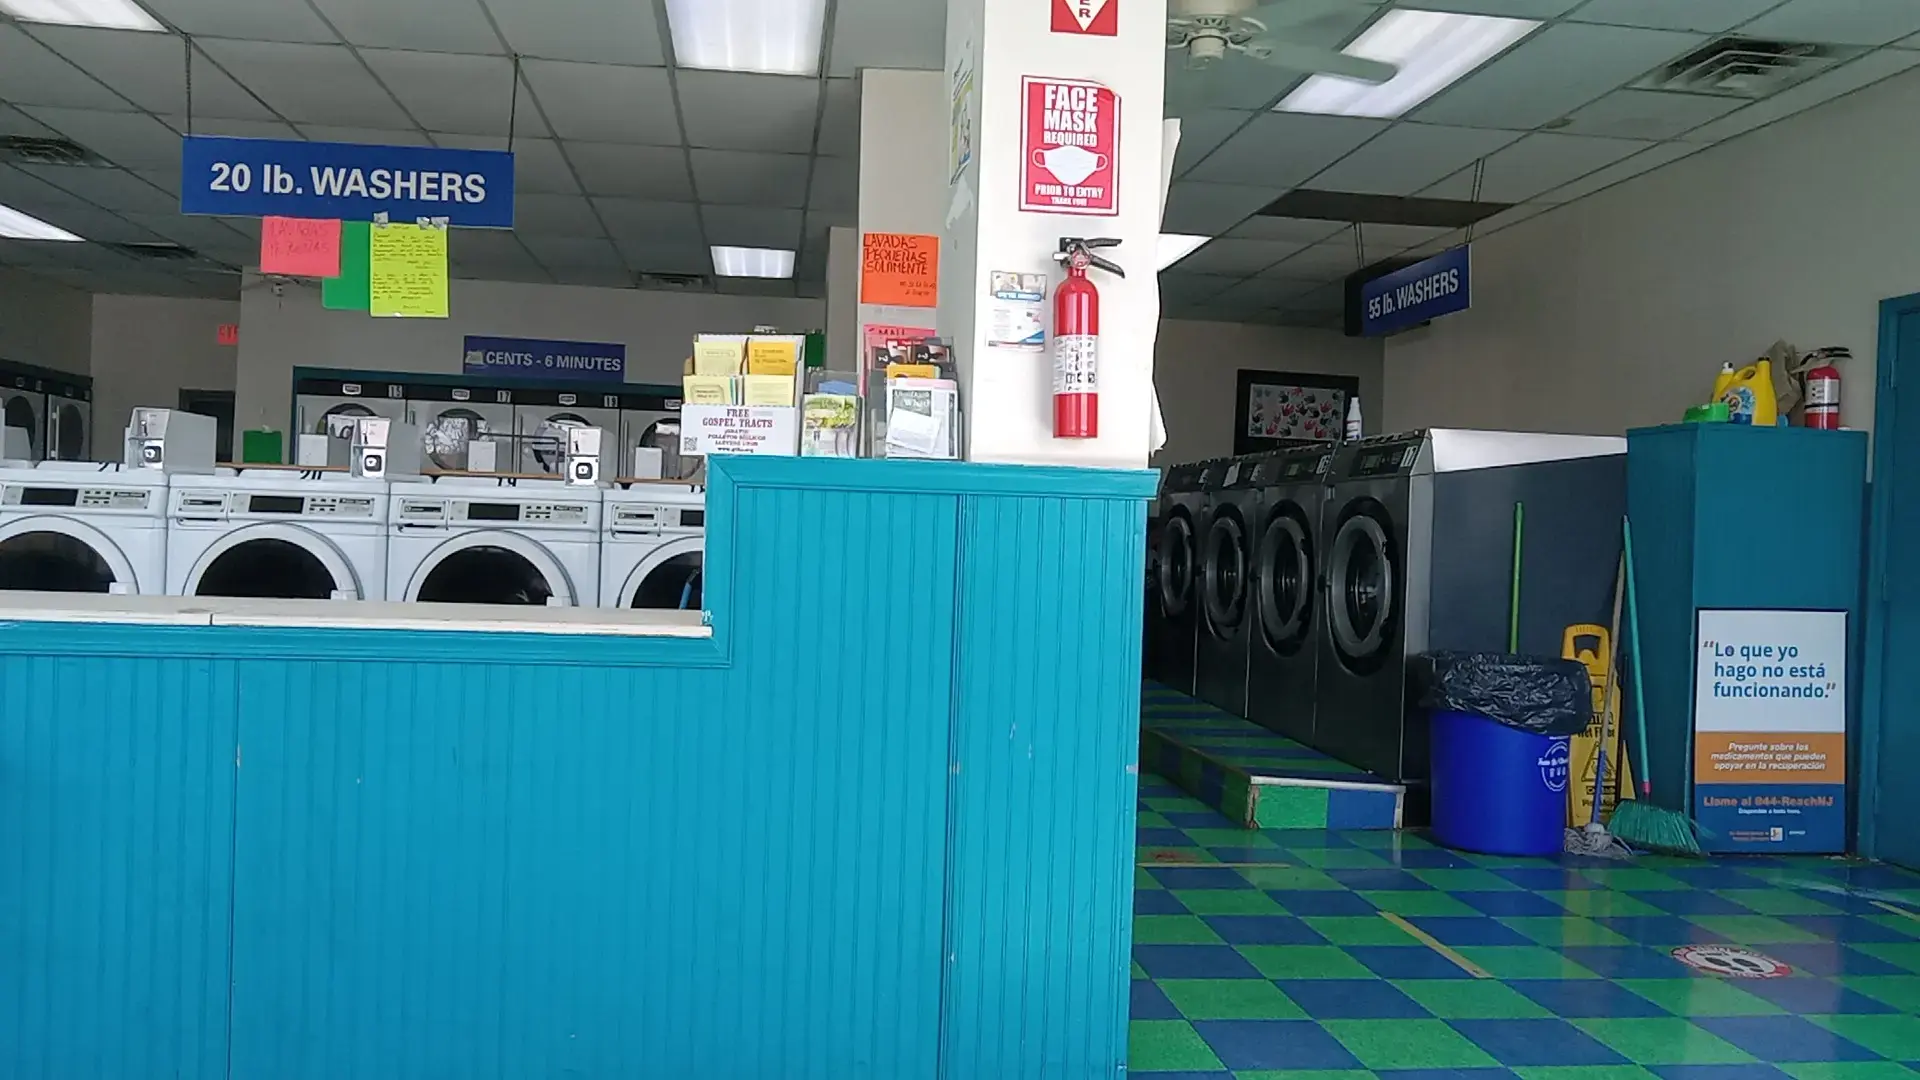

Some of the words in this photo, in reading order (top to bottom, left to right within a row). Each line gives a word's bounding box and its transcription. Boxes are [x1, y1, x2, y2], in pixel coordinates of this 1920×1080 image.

[1044, 85, 1098, 112] FACE
[1044, 110, 1097, 133] MASK
[1043, 132, 1098, 147] REQUIRED
[210, 162, 250, 192] 20
[263, 164, 302, 194] lb.
[310, 166, 486, 203] WASHERS
[1034, 183, 1062, 196] PRIOR
[1063, 185, 1075, 197] TO
[1075, 187, 1104, 199] ENTRY
[863, 234, 918, 249] LAVADAS
[1368, 296, 1381, 320] 55
[1382, 293, 1396, 316] lb.
[1396, 268, 1459, 310] WASHERS
[486, 351, 533, 367] CENTS
[544, 353, 553, 368] 6
[556, 355, 621, 372] MINUTES
[726, 408, 750, 418] FREE
[702, 418, 736, 427] GOSPEL
[739, 419, 773, 428] TRACTS
[1740, 644, 1773, 662] que
[1777, 645, 1798, 662] yo
[1714, 662, 1757, 682] hago
[1762, 664, 1784, 678] no
[1789, 662, 1825, 678] está
[1728, 742, 1768, 752] Pregunte
[1769, 742, 1795, 751] sobre
[1796, 742, 1809, 751] los
[1710, 752, 1774, 761] medicamentos
[1775, 753, 1792, 763] que
[1793, 753, 1826, 763] pueden
[1713, 762, 1743, 772] apoyar
[1758, 762, 1767, 770] la
[1768, 761, 1825, 772] recuperación
[1703, 796, 1738, 807] Llame
[1740, 796, 1751, 807] al
